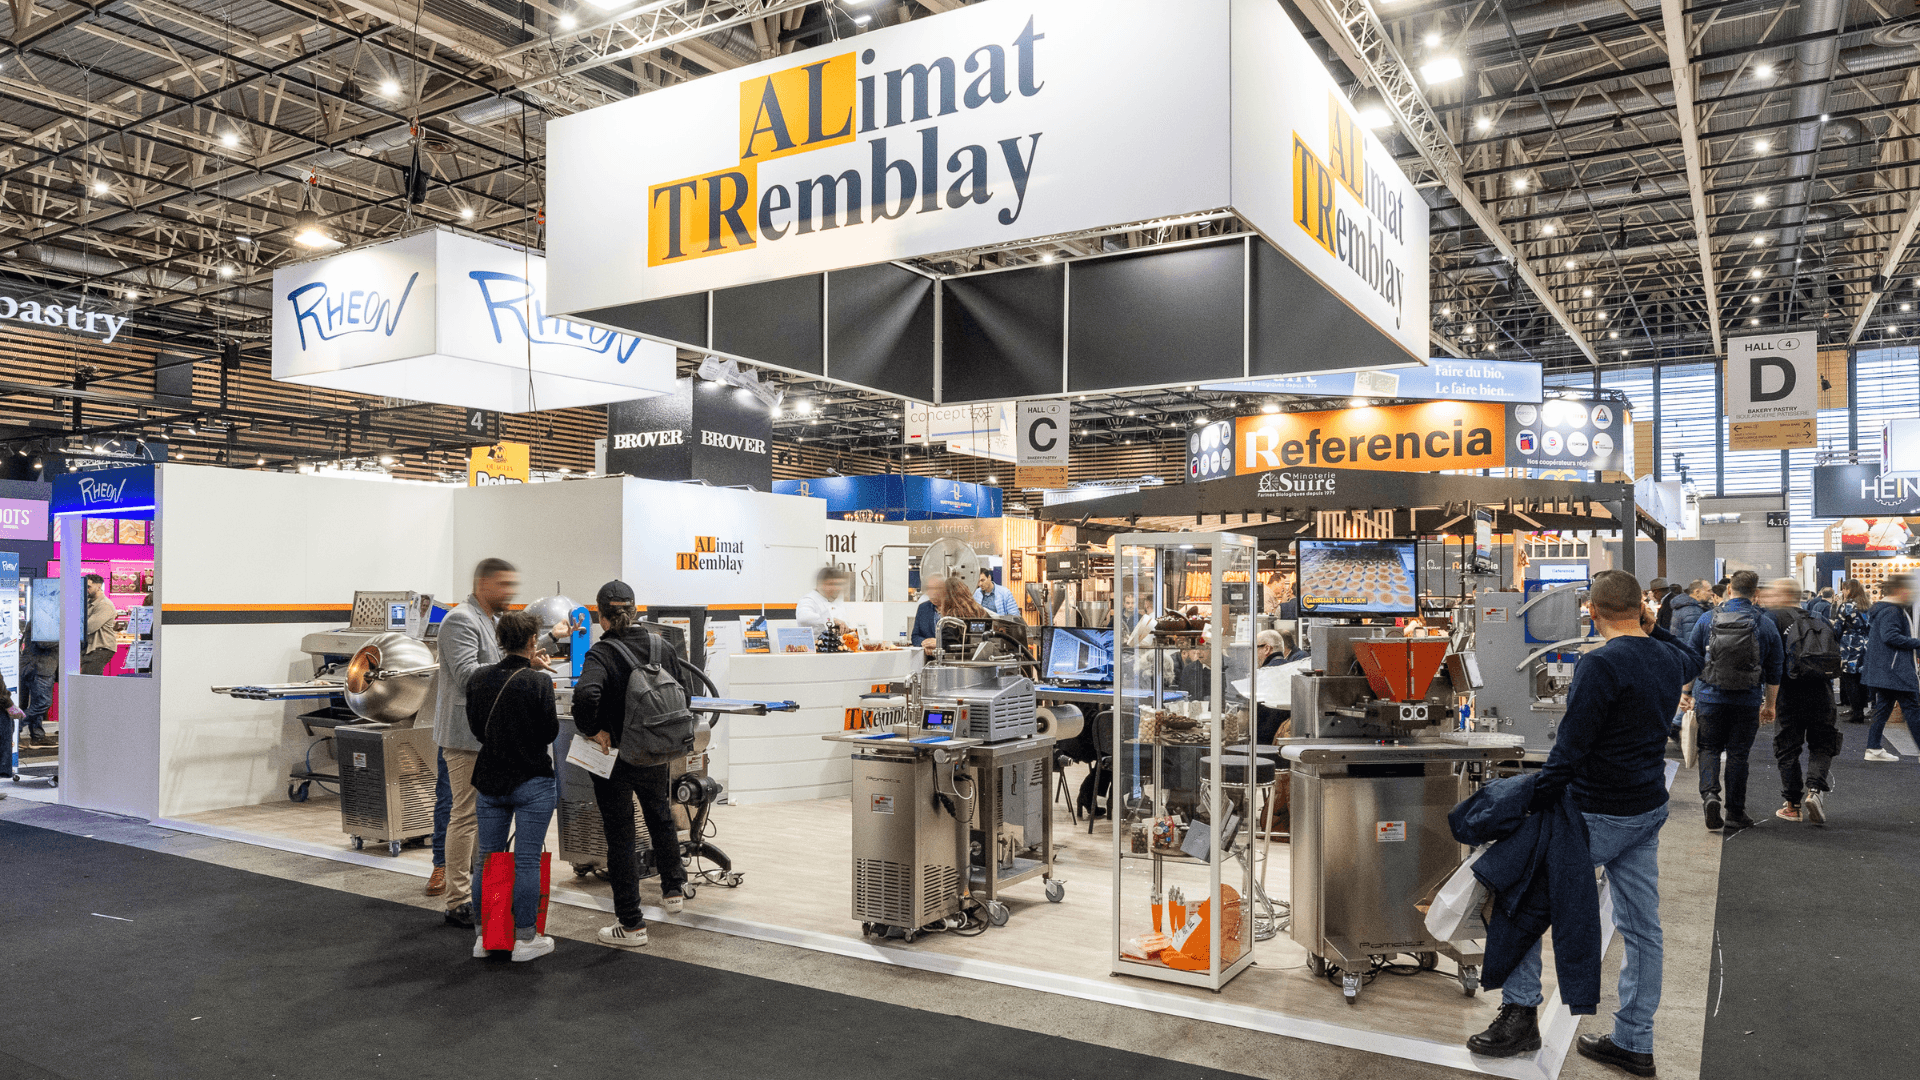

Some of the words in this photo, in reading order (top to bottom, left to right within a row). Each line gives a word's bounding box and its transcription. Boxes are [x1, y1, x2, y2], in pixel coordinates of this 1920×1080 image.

[741, 14, 1045, 160] ALimat
[1329, 104, 1404, 246] ALimat
[653, 126, 1044, 260] TRemblay
[1294, 135, 1404, 330] TRemblay
[287, 270, 419, 351] RHEON
[1745, 342, 1774, 352] HALL
[1435, 364, 1463, 377] Faire
[1465, 365, 1481, 378] du
[1483, 366, 1505, 380] bio,
[1750, 356, 1797, 403] D
[1435, 382, 1449, 394] Le
[1451, 382, 1478, 395] faire
[1479, 383, 1514, 396] bien...
[471, 411, 484, 431] 4
[911, 406, 966, 423] concept
[613, 429, 684, 450] BROVER
[700, 429, 767, 455] BROVER
[1028, 416, 1058, 452] C
[1245, 419, 1492, 468] Referencia
[1278, 472, 1336, 492] Suire
[1292, 471, 1336, 480] Minoterie
[78, 477, 127, 506] RHEON
[0, 508, 30, 526] OTS
[1768, 518, 1789, 526] 4.16
[935, 522, 975, 534] vitrines
[695, 535, 744, 554] ALimat
[677, 553, 744, 575] TRemblay
